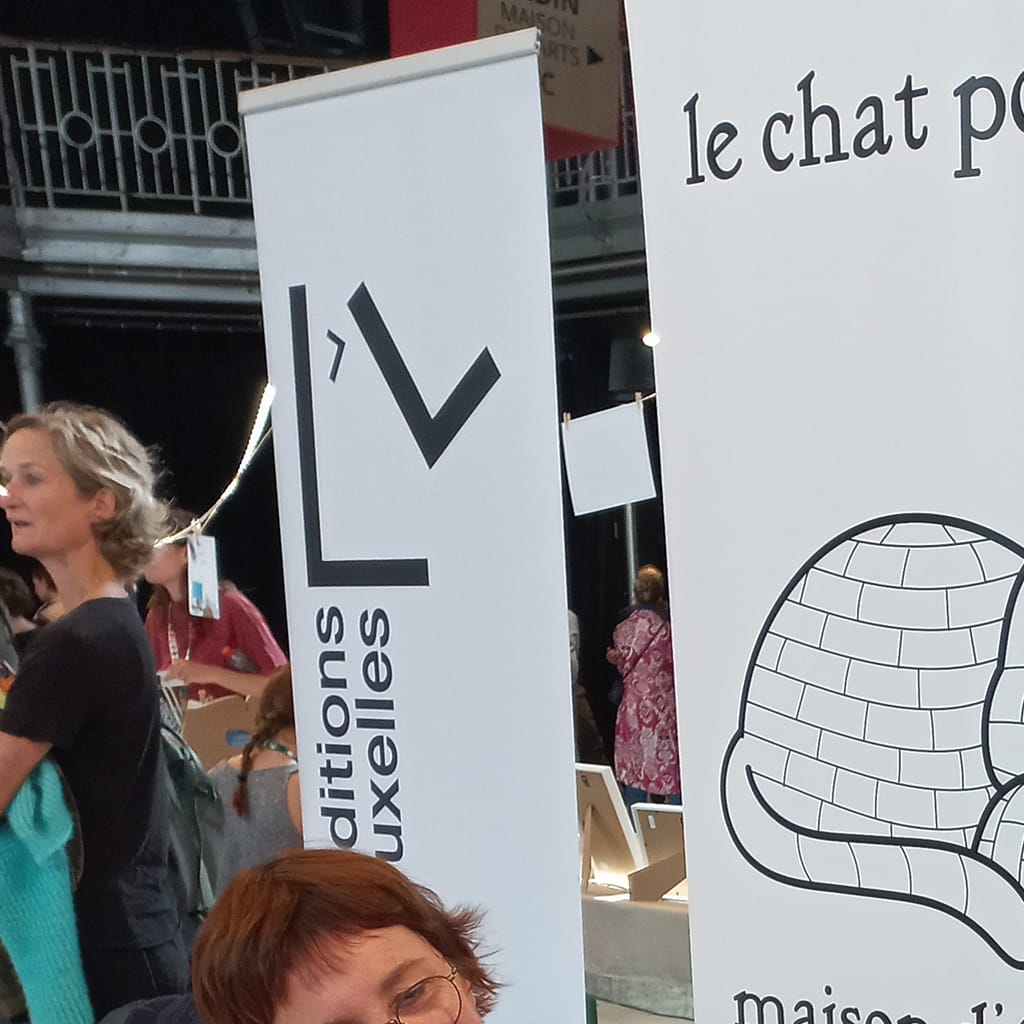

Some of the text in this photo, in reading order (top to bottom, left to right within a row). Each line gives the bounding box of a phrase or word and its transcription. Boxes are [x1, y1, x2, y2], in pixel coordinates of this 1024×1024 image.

[500, 2, 576, 40] MAISON
[684, 92, 742, 185] le
[762, 70, 929, 173] chat
